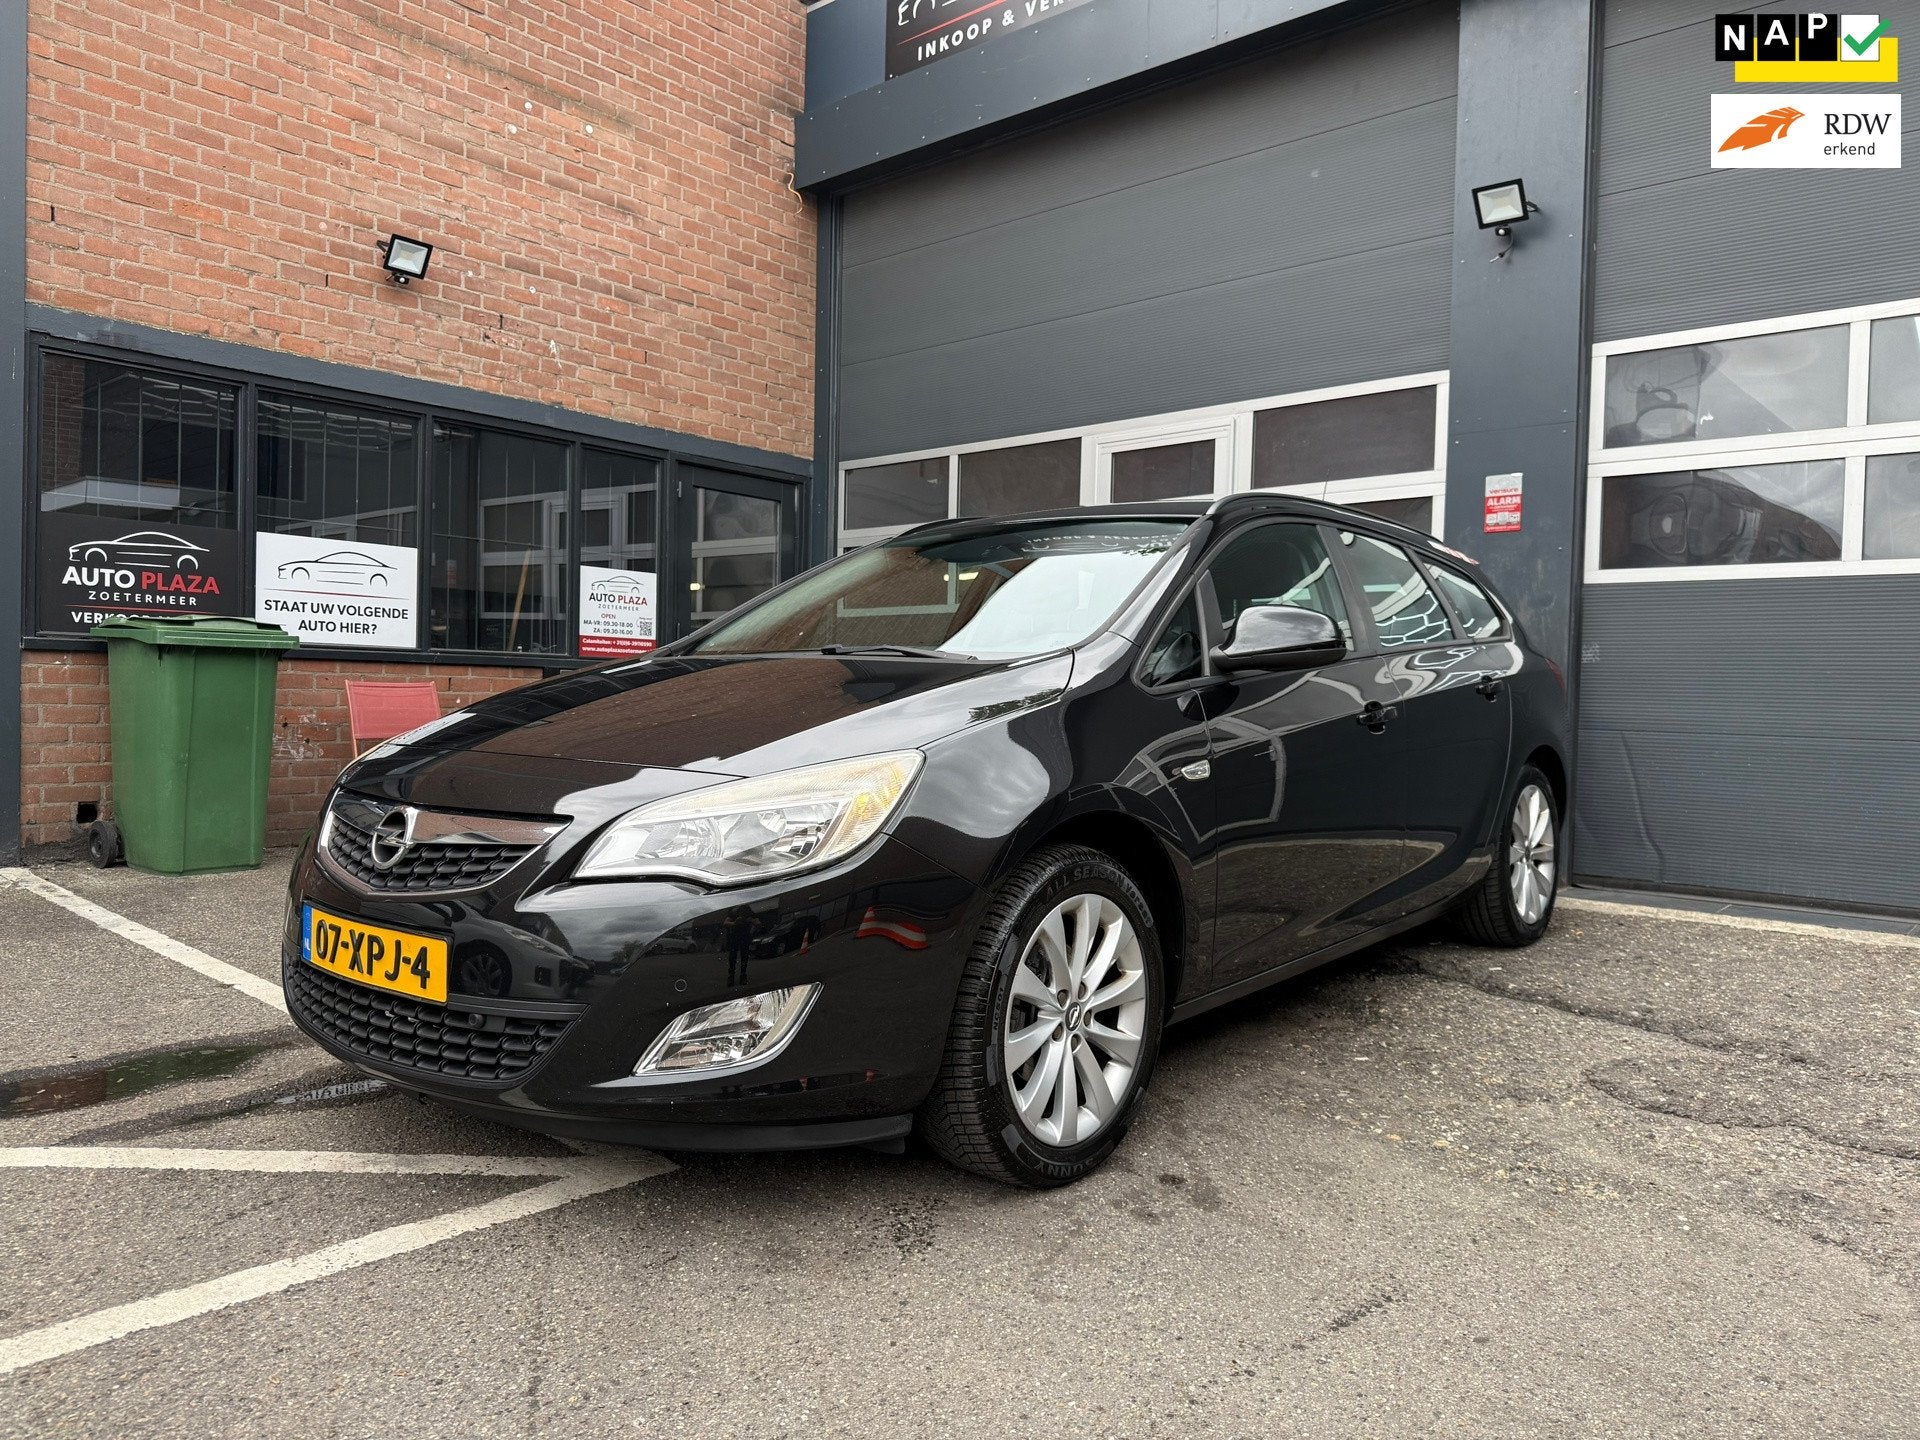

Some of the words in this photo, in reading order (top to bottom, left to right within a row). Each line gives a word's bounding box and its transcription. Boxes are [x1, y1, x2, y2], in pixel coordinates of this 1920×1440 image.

[917, 18, 993, 61] INKOOP
[1001, 9, 1015, 27] &
[1487, 496, 1521, 507] ALARM
[62, 566, 136, 589] AUTO
[140, 571, 220, 595] PLAZA
[88, 590, 197, 606] ZOETERMEER
[589, 592, 616, 603] AUTO
[617, 594, 648, 606] PLAZA
[264, 599, 308, 613] STAAT
[310, 602, 335, 615] UW
[337, 604, 409, 620] VOLGENDE
[598, 603, 639, 611] ZOETERMEER
[298, 619, 337, 632] AUTO
[340, 622, 377, 635] HIER?
[315, 919, 431, 990] 07-XPJ-4
